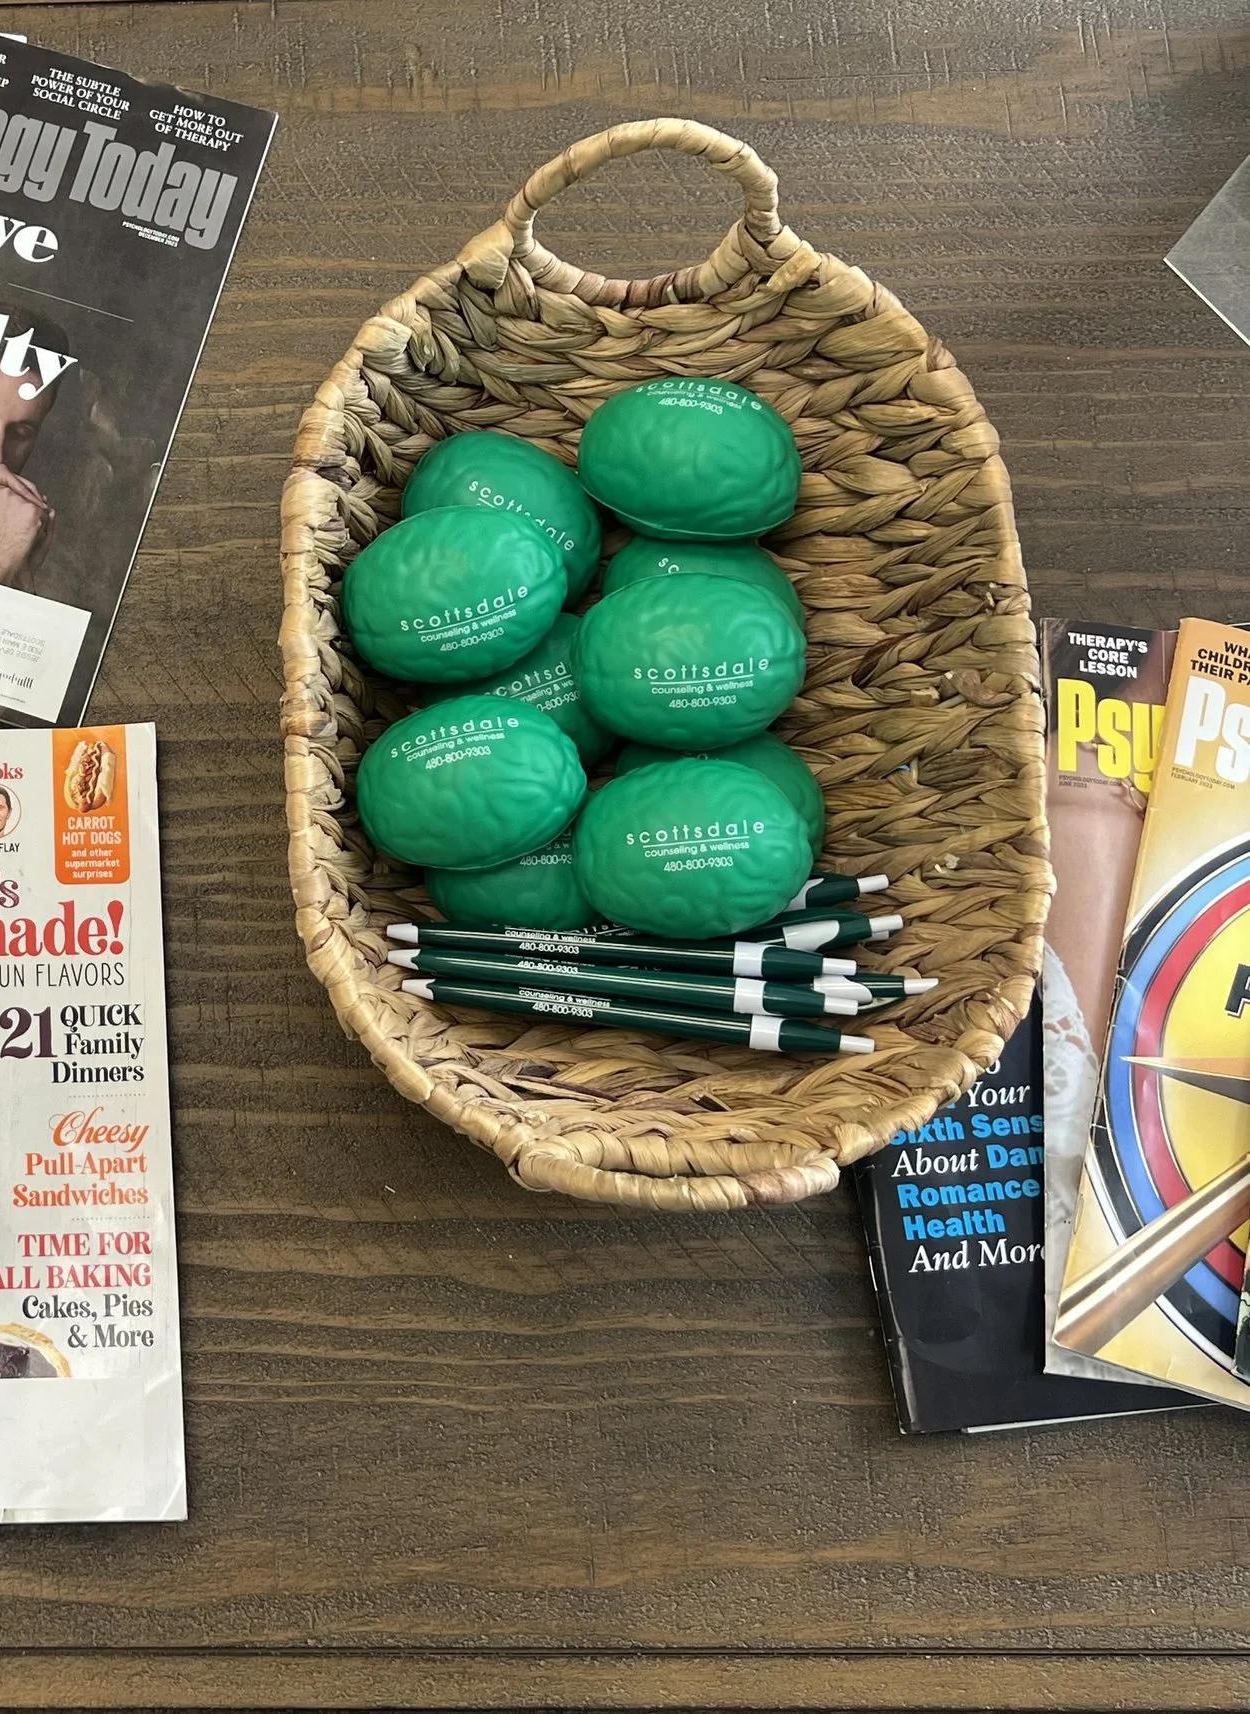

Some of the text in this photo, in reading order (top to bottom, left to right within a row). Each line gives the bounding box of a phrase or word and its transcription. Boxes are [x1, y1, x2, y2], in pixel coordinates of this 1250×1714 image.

[69, 120, 238, 250] Today
[138, 232, 165, 244] DECEMBER
[636, 381, 762, 410] scottsdale
[658, 398, 723, 415] 480-800-9303
[401, 586, 527, 631] scottsdale
[421, 609, 516, 642] counseling & wellness
[440, 627, 504, 651] 480-800-9303
[1068, 633, 1147, 653] THERAPY'S
[1088, 649, 1128, 664] CORE
[634, 658, 768, 679] scottsdale
[1080, 660, 1137, 678] LESSON
[1190, 660, 1233, 680] THEIR
[651, 681, 753, 694] counseling & wellness
[669, 695, 736, 708] 480-800-9303
[67, 816, 115, 830] CARROT
[627, 820, 764, 845] scottsdale
[62, 831, 122, 845] HOT DOGS
[72, 848, 113, 858] and other
[645, 842, 749, 858] counseling & wellness
[64, 858, 120, 869] supermarket
[73, 868, 113, 879] surprises
[664, 857, 733, 873] 480-800-9303
[517, 961, 578, 974] 480-800-9303
[519, 990, 565, 1002] counseling
[532, 1002, 593, 1018] 480-800-9303
[0, 1003, 142, 1059] 21 QUICK
[64, 1032, 144, 1059] Family
[51, 1061, 144, 1084] Dinners
[967, 1081, 1030, 1108] Your
[49, 1106, 150, 1152] Cheesy
[25, 1152, 148, 1180] Pull-Apart
[892, 1148, 979, 1177] About
[12, 1183, 148, 1208] Sandwiches
[897, 1178, 1040, 1208] Romance
[903, 1209, 1005, 1240] Health
[909, 1240, 969, 1273] And
